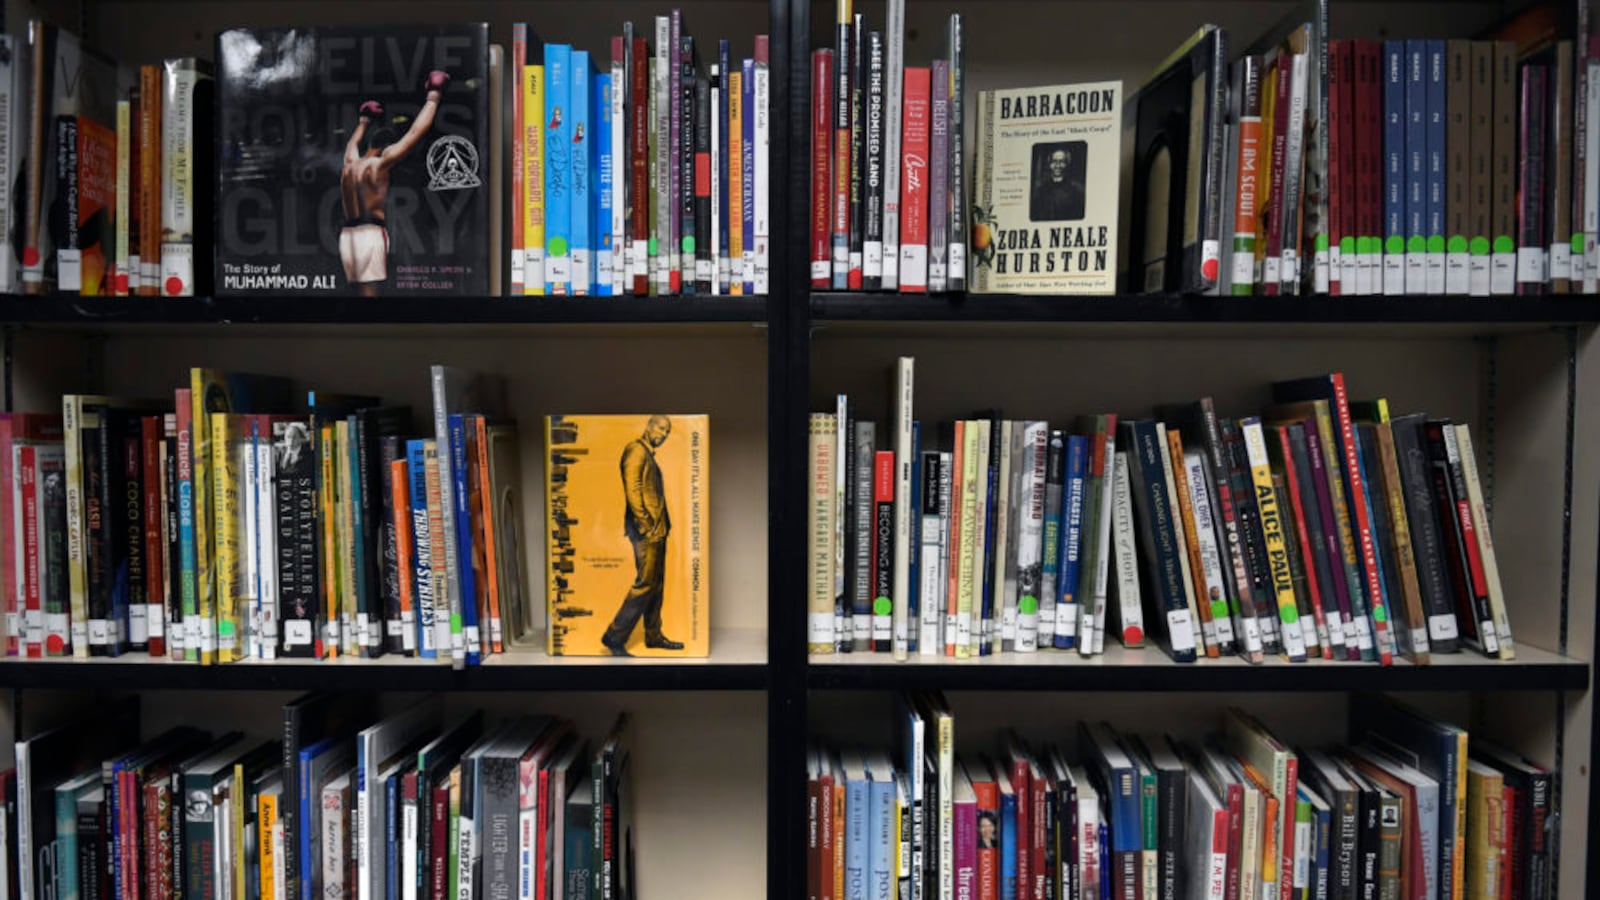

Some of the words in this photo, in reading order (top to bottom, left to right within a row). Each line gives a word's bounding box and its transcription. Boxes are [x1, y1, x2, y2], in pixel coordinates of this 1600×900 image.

[871, 50, 881, 68] SEE
[1391, 53, 1399, 83] MARCH
[1413, 52, 1421, 82] MARCH
[1432, 53, 1440, 82] MARCH
[871, 72, 881, 93] THE
[933, 100, 948, 137] RELISH
[1000, 89, 1114, 120] BARRACOON
[526, 125, 538, 157] MARCH
[870, 96, 881, 153] PROMISED
[600, 154, 612, 184] LITTLE
[743, 139, 753, 172] JAMES
[869, 157, 880, 188] LAND
[1242, 148, 1257, 172] AM
[600, 188, 611, 209] FISH
[684, 162, 693, 204] BROOKS
[743, 173, 752, 222] BUCHANAN
[1240, 175, 1257, 218] SCOUT
[998, 228, 1042, 251] ZORA
[1049, 226, 1108, 249] NEALE
[224, 264, 241, 273] The
[243, 263, 269, 275] Story
[270, 263, 281, 273] of
[996, 250, 1107, 274] HURSTON
[224, 275, 308, 289] MUHAMMAD
[312, 275, 336, 289] ALI
[177, 430, 191, 479] Chuck
[815, 444, 831, 496] UNBOWED
[1033, 430, 1047, 479] SAMURAI
[1191, 465, 1207, 504] MICHAEL
[1336, 386, 1352, 438] JENNIFER
[1363, 528, 1376, 566] PABLO
[68, 489, 78, 527] GEORGE
[88, 497, 101, 529] CASH
[127, 481, 138, 520] COCO
[177, 480, 192, 527] Close
[280, 478, 293, 538] ROALD
[1031, 482, 1044, 521] RISING
[1070, 477, 1083, 526] OUTCASTS
[1115, 474, 1131, 534] AUDACITY
[1198, 505, 1212, 530] OHER
[1460, 502, 1474, 533] PRINCE
[299, 478, 313, 594] STORYTELLER
[413, 509, 432, 568] THROWING
[879, 505, 891, 568] BECOMING
[963, 500, 977, 556] LEAVING
[1068, 528, 1080, 562] UNITED
[1256, 485, 1282, 544] ALICE
[1270, 550, 1291, 596] PAUL
[129, 525, 142, 580] CHANEL
[1121, 551, 1135, 586] HOPE
[282, 548, 295, 596] DAHL
[692, 557, 700, 592] COMMON
[962, 557, 974, 599] CHINA
[416, 567, 436, 626] STRIKES
[809, 796, 818, 820] Manny
[822, 786, 832, 818] GORDON
[942, 800, 952, 816] The
[1532, 780, 1547, 807] SYBIL
[263, 803, 273, 829] Anne
[491, 814, 509, 853] LIGHTER
[822, 818, 831, 849] RAMSAY
[942, 818, 952, 839] Many
[1340, 814, 1355, 837] Bill
[264, 831, 275, 857] Frank
[459, 830, 472, 885] TEMPLE
[982, 850, 997, 900] CONDOL
[1337, 841, 1354, 887] Bryson
